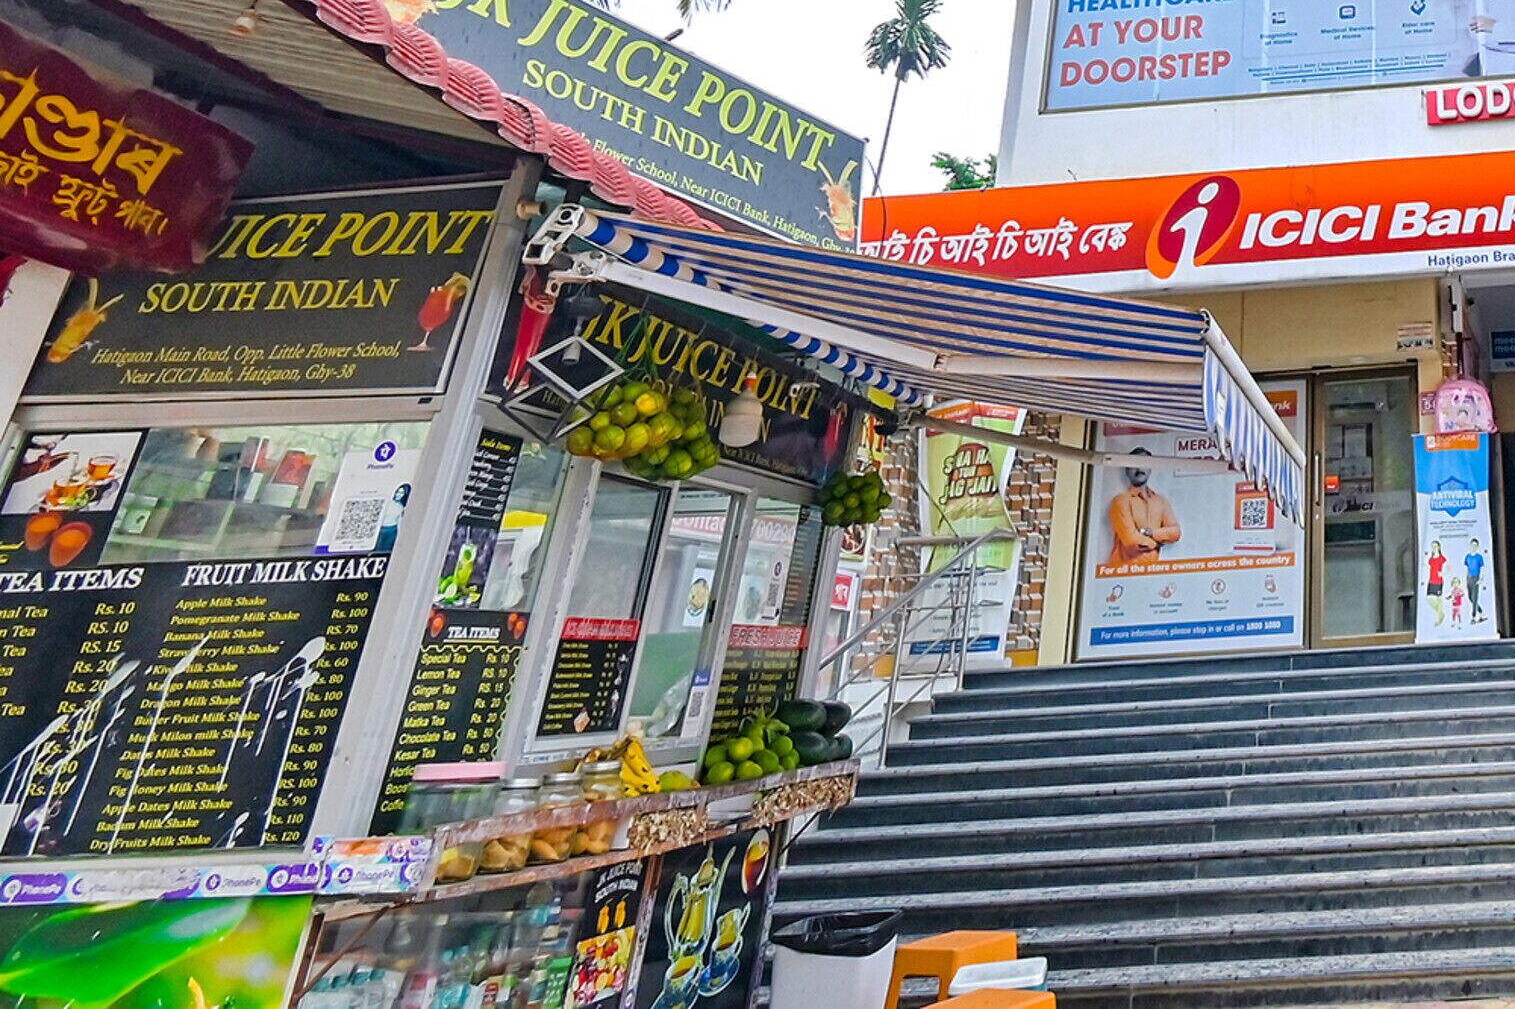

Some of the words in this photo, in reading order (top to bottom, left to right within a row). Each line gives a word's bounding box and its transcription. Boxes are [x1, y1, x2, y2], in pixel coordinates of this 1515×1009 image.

[1063, 22, 1104, 49] AT
[1114, 14, 1204, 45] YOUR
[1060, 50, 1232, 87] DOORSTEP
[522, 59, 647, 135] SOUTH
[650, 115, 764, 186] INDIAN
[682, 70, 836, 173] POINT
[637, 157, 678, 188] School,
[680, 176, 708, 198] Near
[709, 188, 744, 211] ICICI
[742, 202, 771, 227] Bank,
[773, 216, 820, 247] Hatigaon,
[312, 210, 497, 258] POINT
[1238, 203, 1381, 249] ICICI
[1427, 250, 1490, 268] Hatigaon
[138, 280, 266, 315] SOUTH
[263, 278, 401, 311] INDIAN
[91, 348, 154, 368] Hatigaon
[154, 346, 191, 364] Main
[192, 346, 230, 363] Road,
[233, 344, 265, 366] Opp.
[267, 343, 305, 361] Little
[306, 342, 353, 360] Flower
[352, 340, 402, 359] School,
[628, 316, 736, 389] JUICE
[119, 368, 156, 386] Near
[155, 368, 198, 384] ICICI
[197, 367, 234, 386] Bank,
[236, 364, 301, 386] Hatigaon,
[305, 363, 357, 384] Ghy-38
[1177, 438, 1218, 452] MERA
[181, 563, 251, 588] FRUIT
[249, 560, 309, 584] MILK
[311, 557, 387, 581] SHAKE
[1099, 565, 1115, 576] For
[1116, 563, 1129, 574] all
[1130, 563, 1146, 573] the
[1147, 562, 1170, 573] store
[1172, 560, 1206, 571] owners
[1207, 559, 1237, 569] across
[1239, 555, 1254, 566] the
[1256, 555, 1291, 567] country
[48, 567, 145, 592] ITEMS
[24, 605, 49, 619] Tea
[94, 603, 115, 616] Rs.
[119, 601, 136, 614] 10
[175, 598, 208, 610] Apple
[209, 597, 234, 608] Milk
[236, 595, 268, 607] Shake
[336, 592, 354, 603] Rs.
[354, 591, 369, 602] 90
[12, 625, 37, 638] Tea
[87, 622, 109, 635] RS.
[112, 620, 130, 633] 10
[170, 614, 241, 627] Pomegranate
[242, 612, 266, 624] Milk
[267, 611, 301, 622] Shake
[331, 609, 348, 620] Rs.
[349, 607, 368, 618] 100
[447, 626, 469, 639] TEA
[469, 626, 501, 640] ITEMS
[3, 644, 27, 657] Tea
[80, 641, 102, 654] RS.
[105, 640, 122, 653] 15
[421, 653, 451, 666] Special
[452, 653, 468, 664] Tea
[112, 836, 148, 848] Fruits
[150, 836, 175, 848] Milk
[177, 834, 212, 846] Shake
[281, 830, 301, 842] 120
